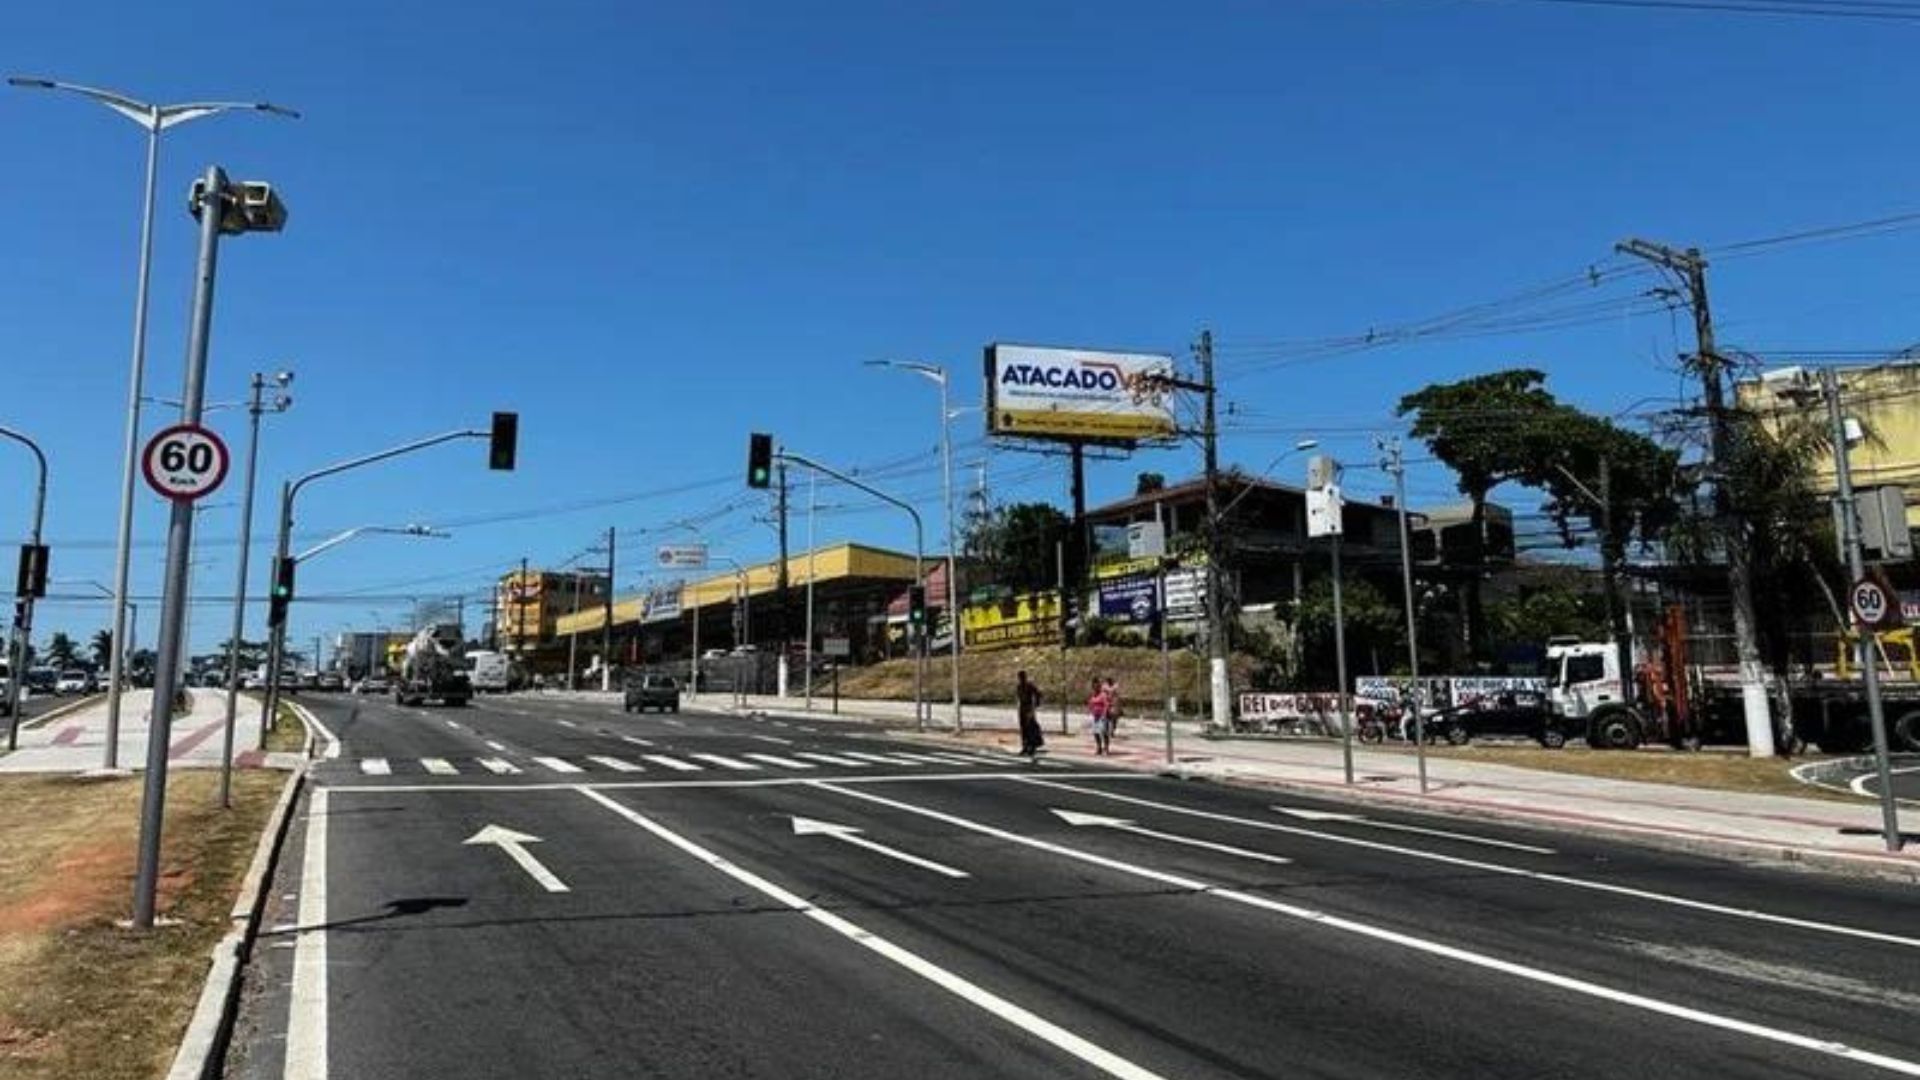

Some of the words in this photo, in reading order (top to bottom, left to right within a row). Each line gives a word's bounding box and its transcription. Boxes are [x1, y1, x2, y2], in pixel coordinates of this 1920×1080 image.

[1002, 364, 1116, 390] ATACADO
[160, 440, 213, 474] 60
[1857, 589, 1881, 609] 60
[1243, 696, 1266, 713] REI
